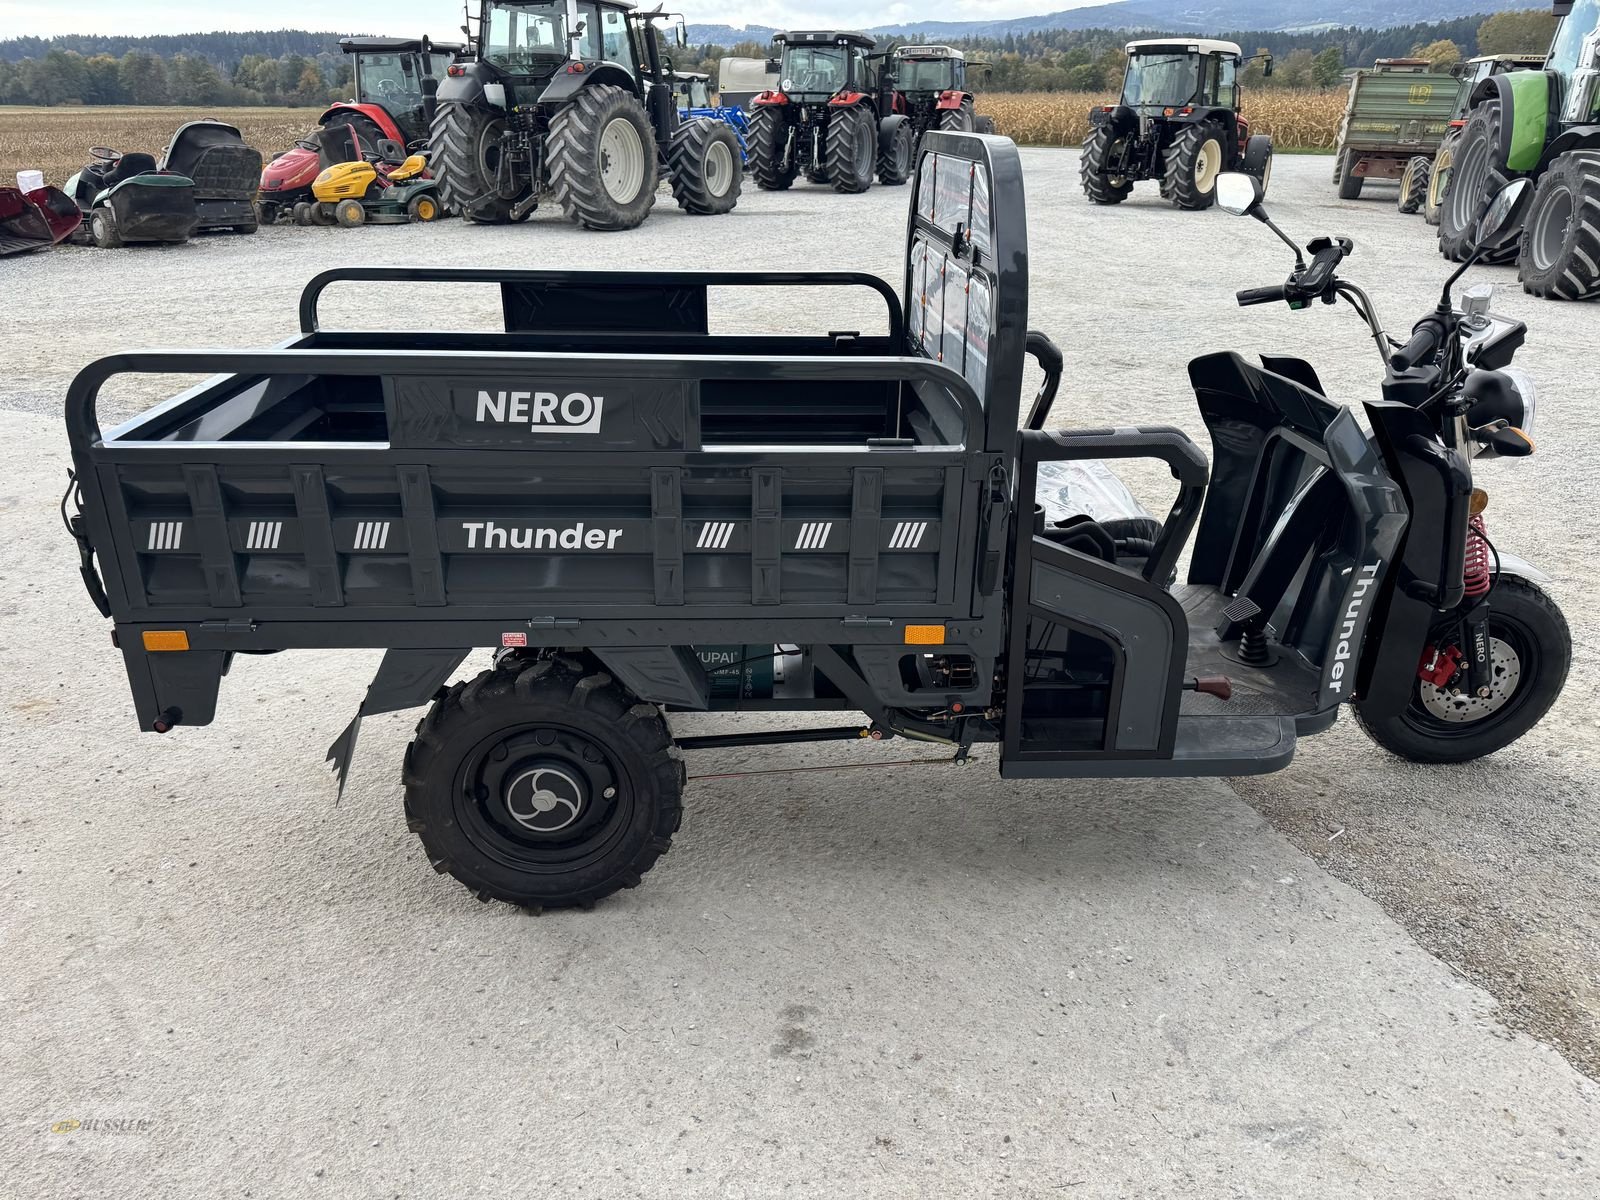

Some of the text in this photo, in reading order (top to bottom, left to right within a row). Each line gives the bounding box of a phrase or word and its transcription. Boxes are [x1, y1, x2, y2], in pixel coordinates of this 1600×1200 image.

[476, 391, 595, 426] NERO
[462, 522, 622, 549] Thunder
[1328, 559, 1381, 693] Thunder
[1475, 633, 1486, 663] NERO
